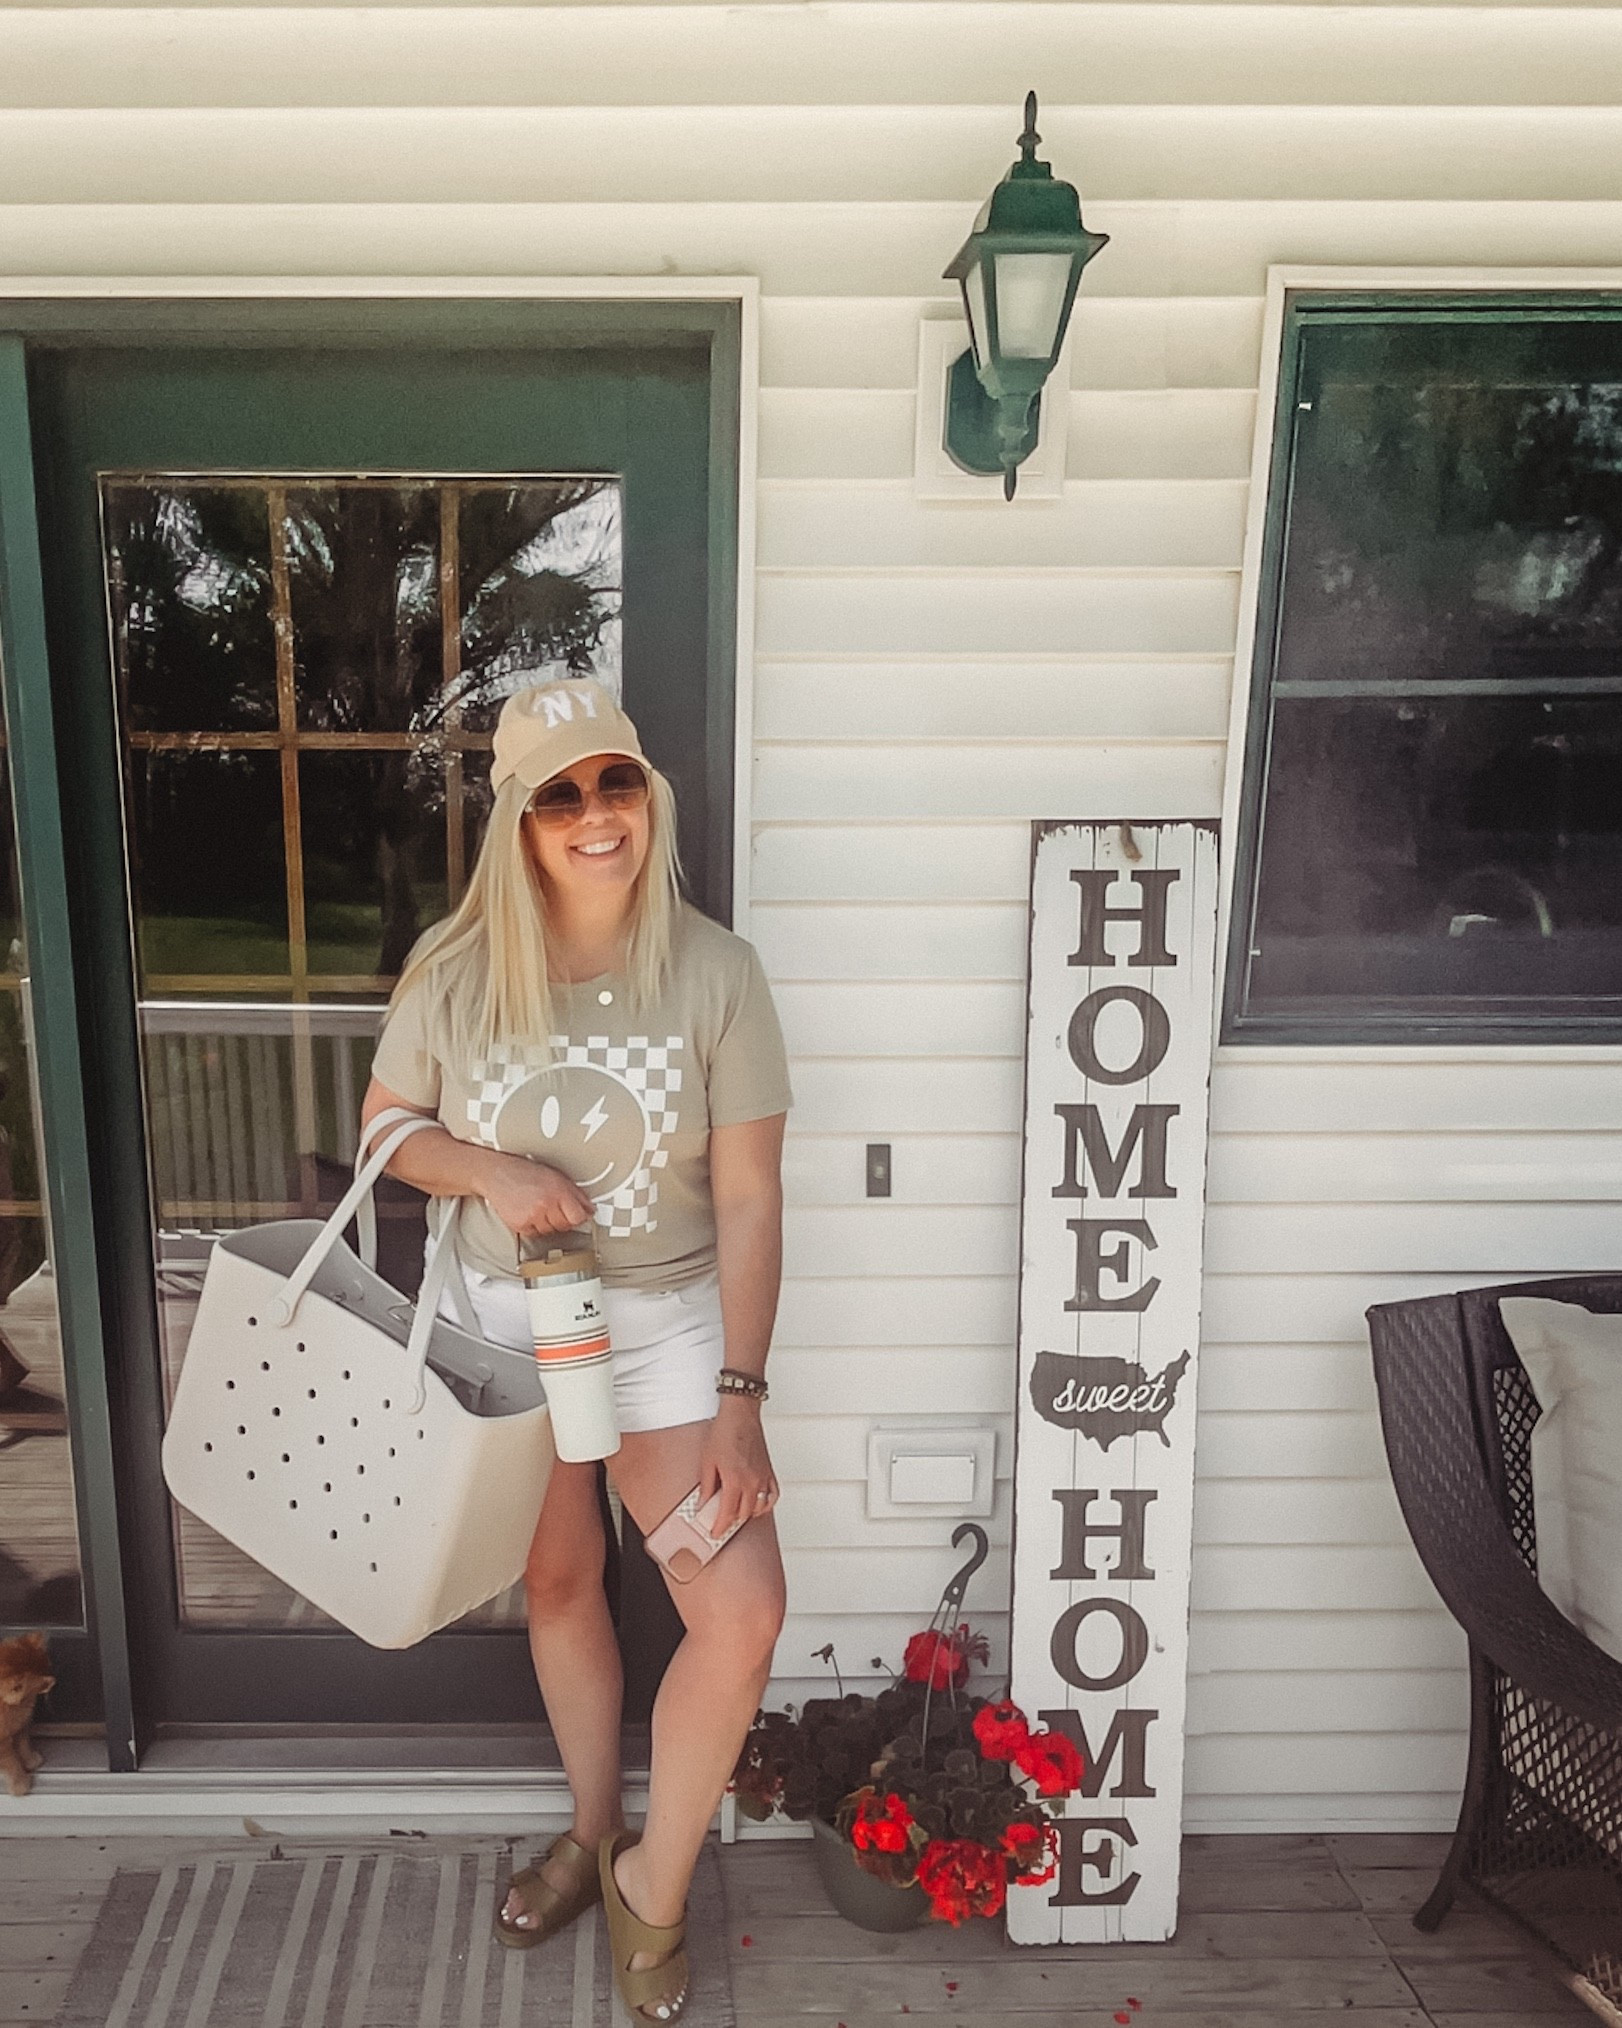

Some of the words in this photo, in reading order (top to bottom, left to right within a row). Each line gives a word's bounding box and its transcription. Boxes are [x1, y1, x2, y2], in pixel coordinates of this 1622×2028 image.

[533, 690, 597, 728] NY
[1051, 869, 1181, 1312] HOME
[1052, 1374, 1167, 1413] sweet
[1035, 1488, 1159, 1907] HOME
